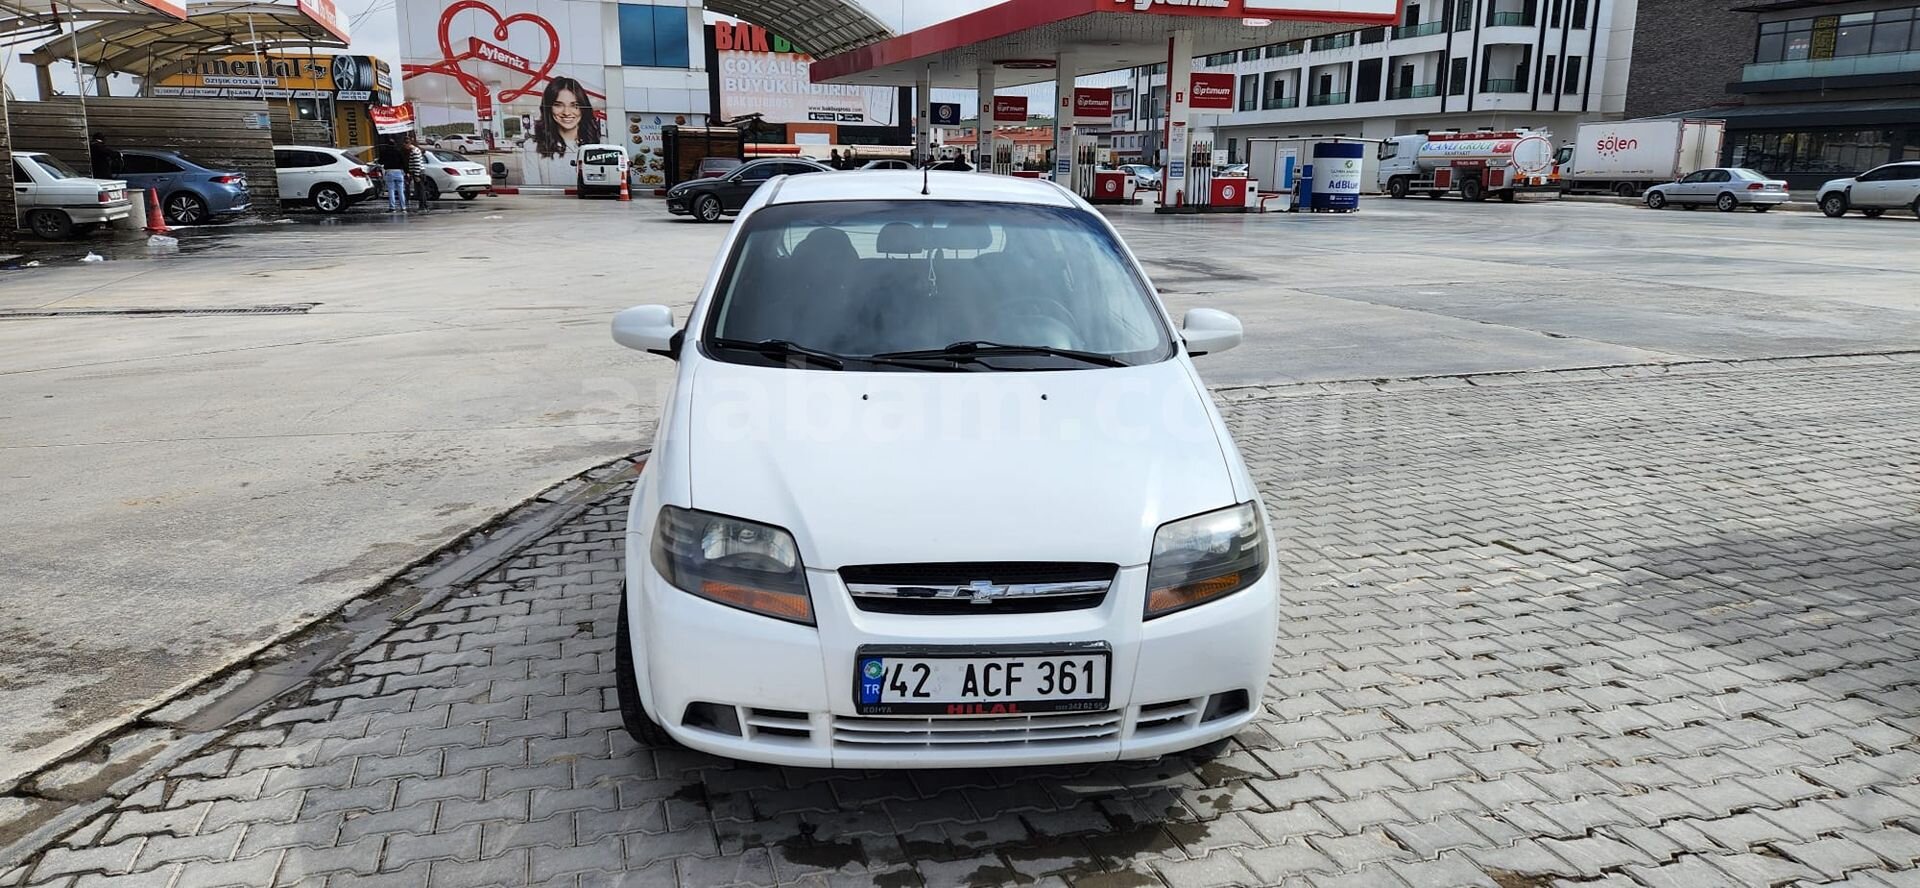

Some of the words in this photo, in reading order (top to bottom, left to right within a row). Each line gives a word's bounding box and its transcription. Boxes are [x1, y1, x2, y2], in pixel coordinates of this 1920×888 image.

[715, 21, 769, 51] BAK
[479, 43, 525, 69] Aytemiz
[725, 59, 762, 75] ÇOK
[726, 75, 788, 93] BÜYÜK
[1328, 180, 1358, 189] AdBlue
[864, 684, 879, 694] TR
[890, 664, 931, 697] 42
[961, 663, 1024, 697] ACF
[1037, 660, 1094, 695] 361
